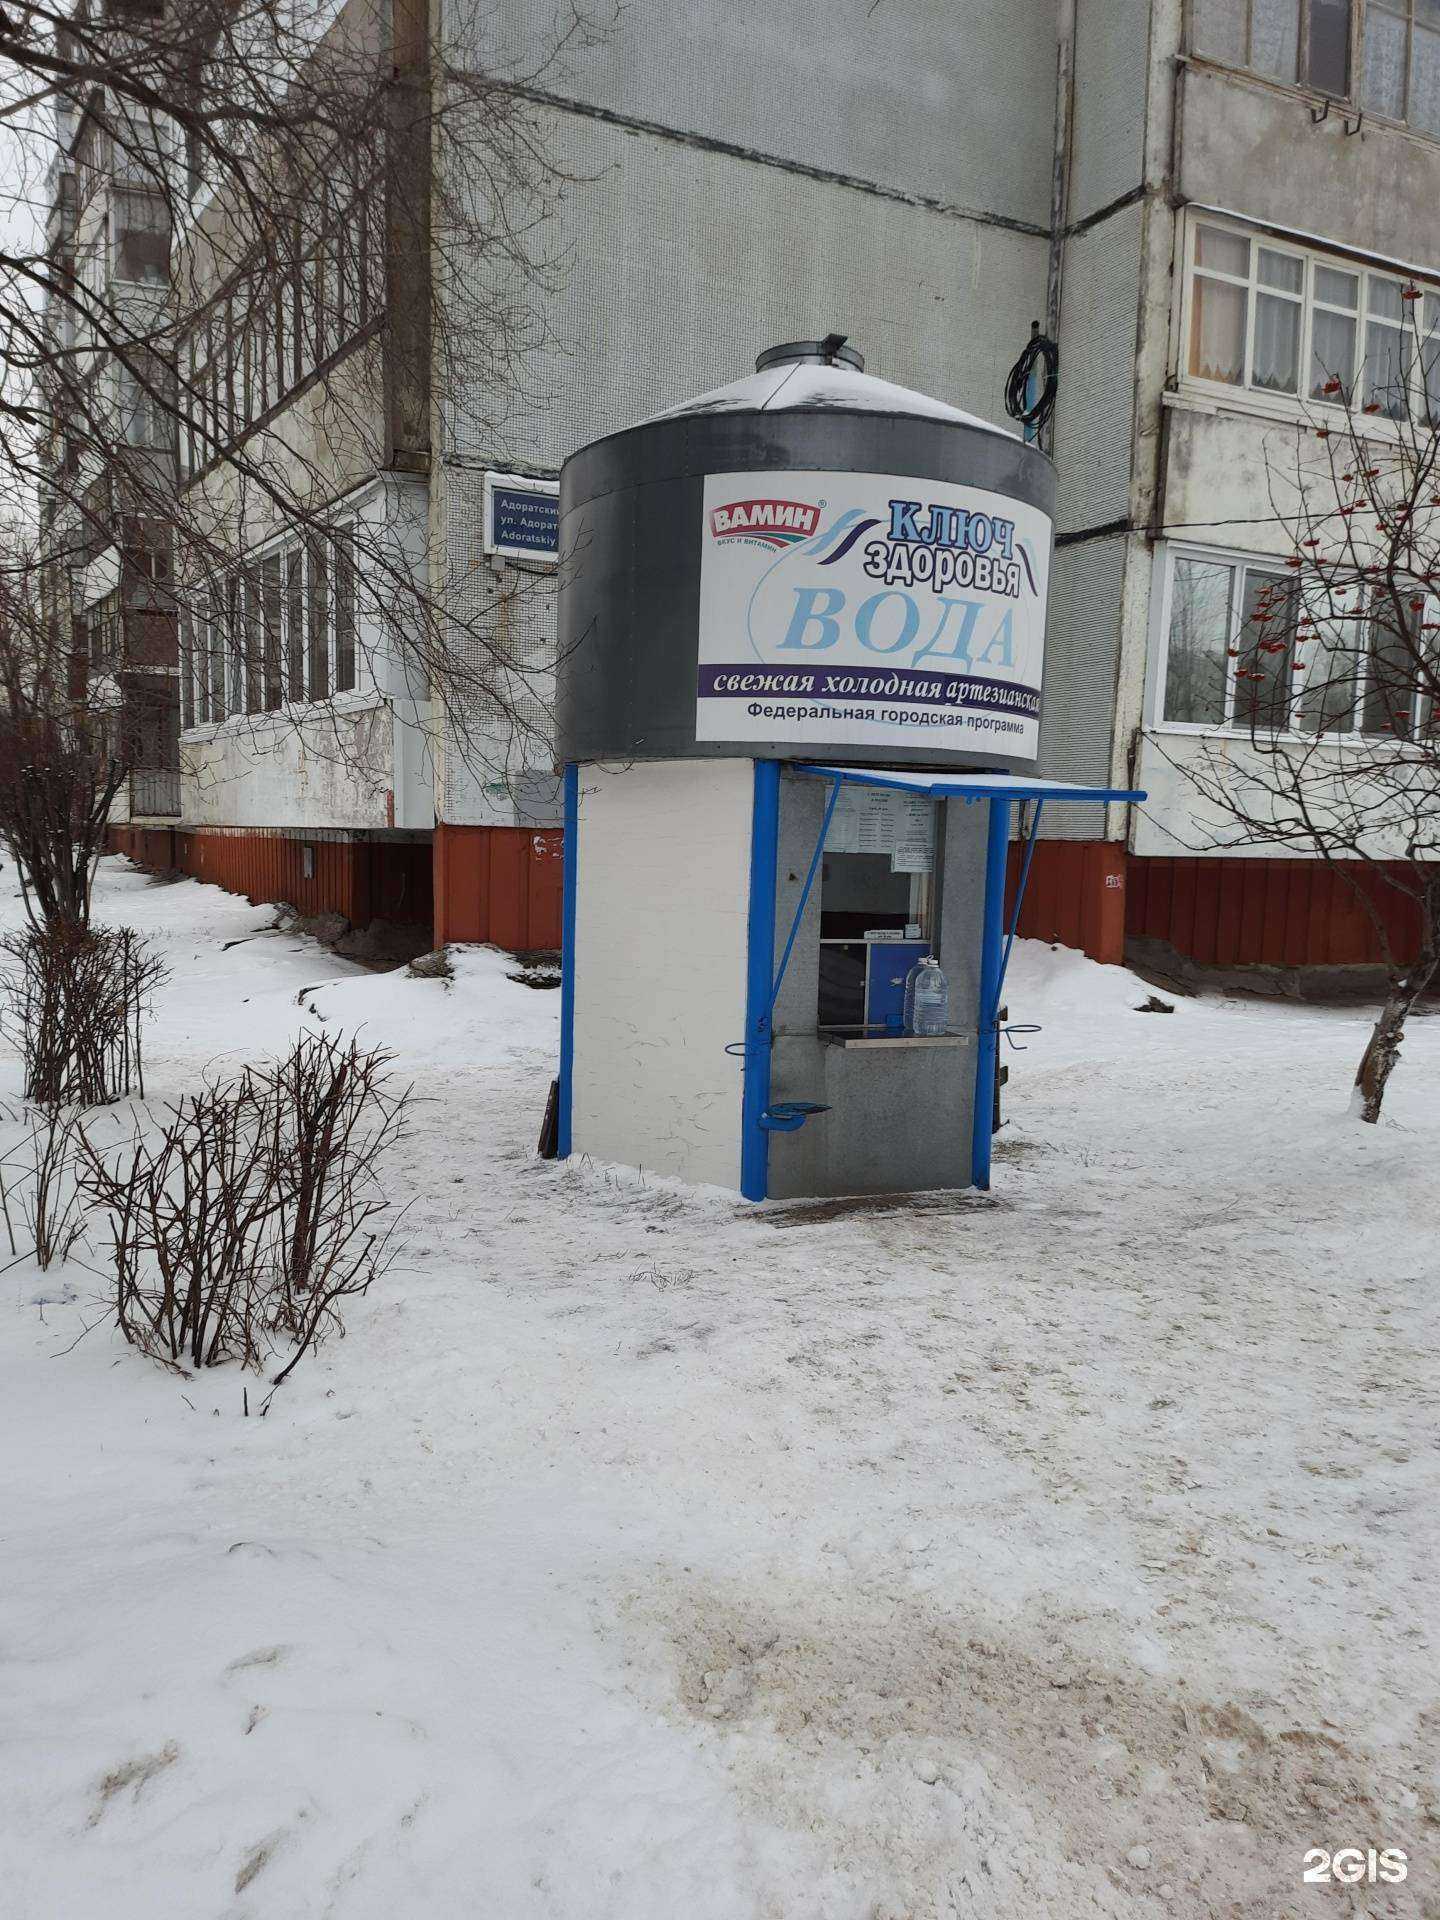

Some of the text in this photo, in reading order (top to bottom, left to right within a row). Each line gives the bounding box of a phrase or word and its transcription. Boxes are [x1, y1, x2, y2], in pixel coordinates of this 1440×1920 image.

[501, 516, 517, 525] ул.
[713, 504, 815, 533] ВАМИН
[888, 499, 1015, 560] КЛЮЧ
[717, 537, 736, 546] ВКУС
[744, 537, 777, 553] ВИТАМИН
[776, 587, 1014, 674] ВОДА
[713, 673, 815, 692] свежая
[821, 672, 943, 699] холодная
[747, 702, 1024, 734] Федеральная городская программа
